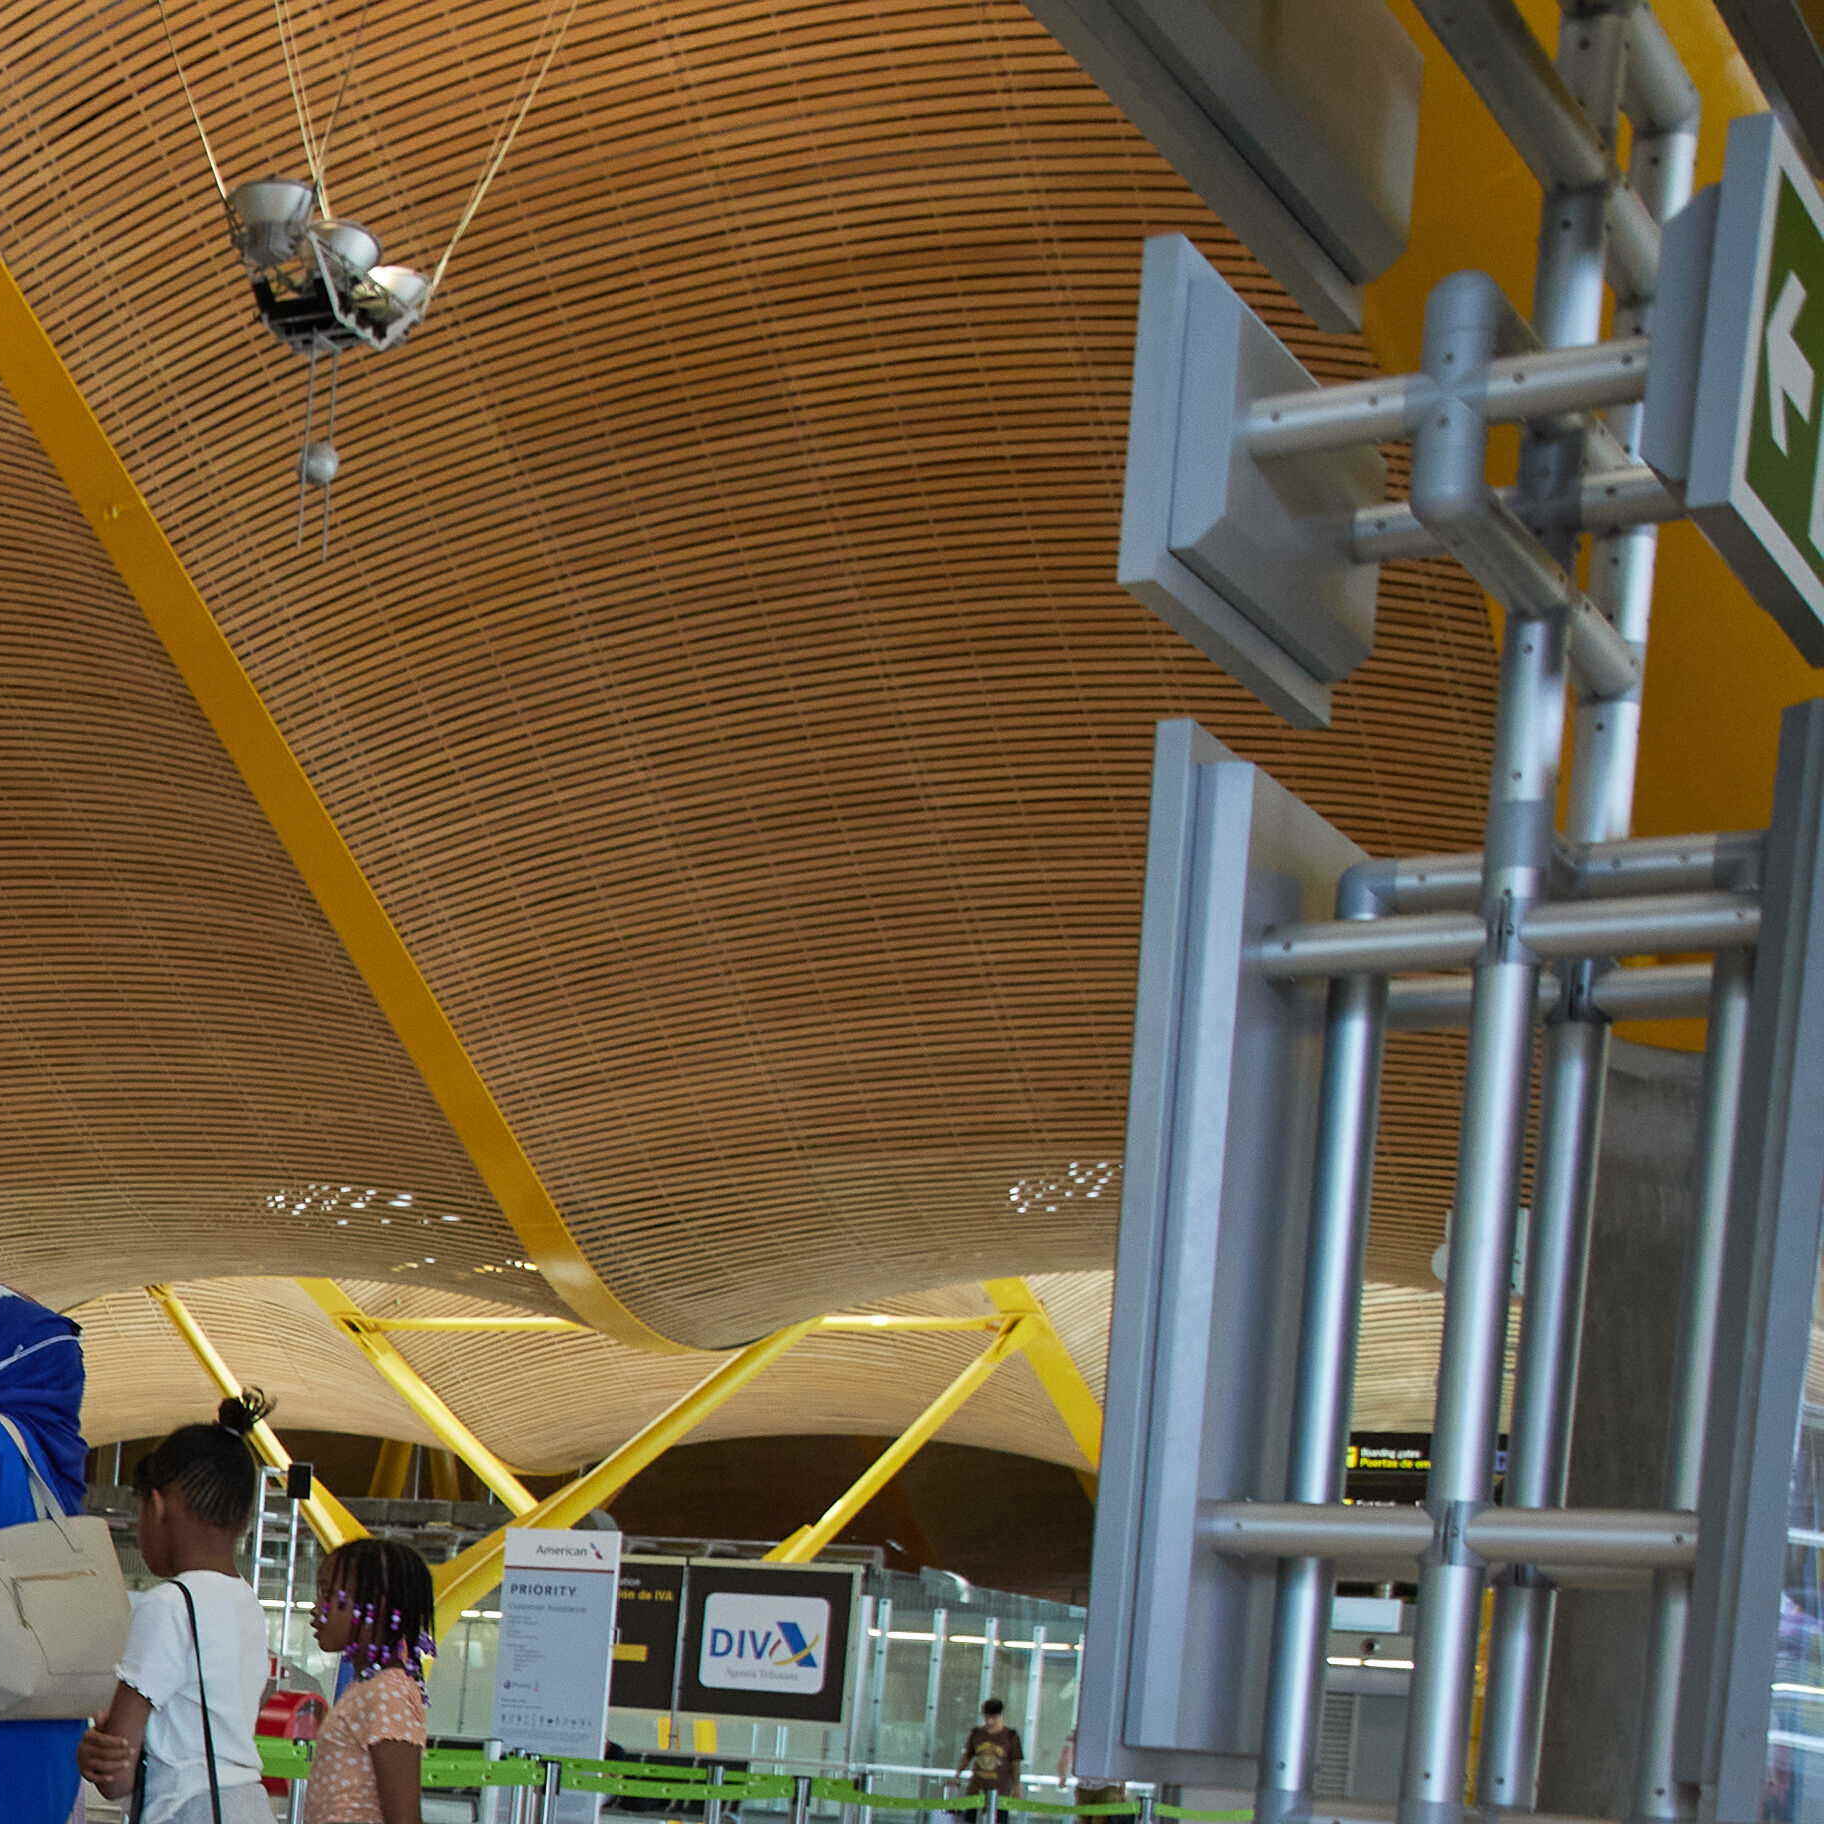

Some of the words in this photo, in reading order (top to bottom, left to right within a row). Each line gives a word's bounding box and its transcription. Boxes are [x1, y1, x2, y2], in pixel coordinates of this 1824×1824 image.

[536, 1544, 588, 1556] American
[510, 1582, 577, 1597] PRIORITY
[655, 1589, 673, 1601] IVA
